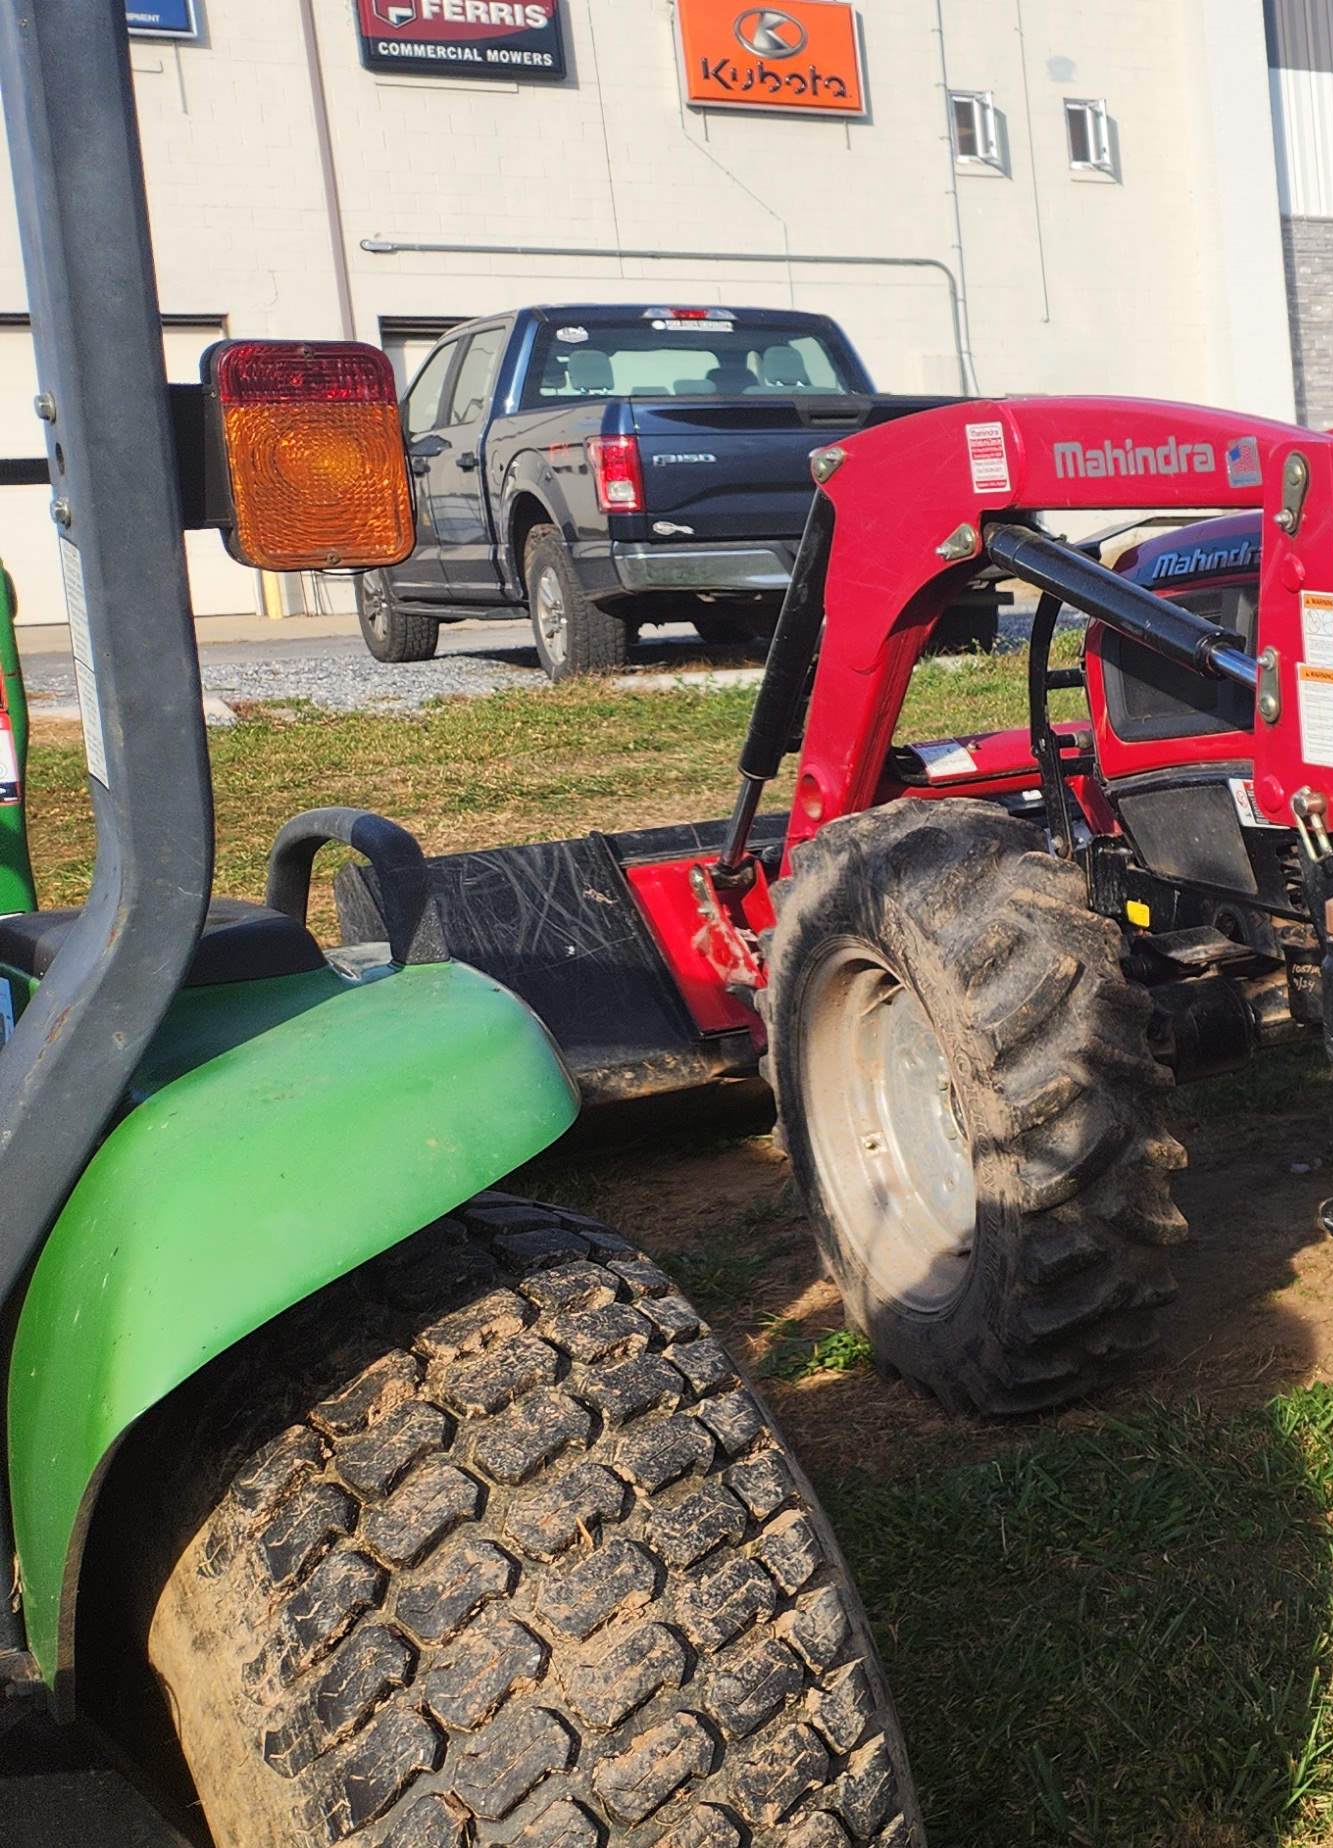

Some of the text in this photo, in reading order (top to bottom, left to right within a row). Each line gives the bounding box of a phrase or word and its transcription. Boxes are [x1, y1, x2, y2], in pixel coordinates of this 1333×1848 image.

[422, 0, 549, 29] FERRIS
[378, 41, 553, 66] COMMERCIAL MOWERS
[701, 57, 848, 98] Kubota
[1054, 435, 1216, 478] Mahindra
